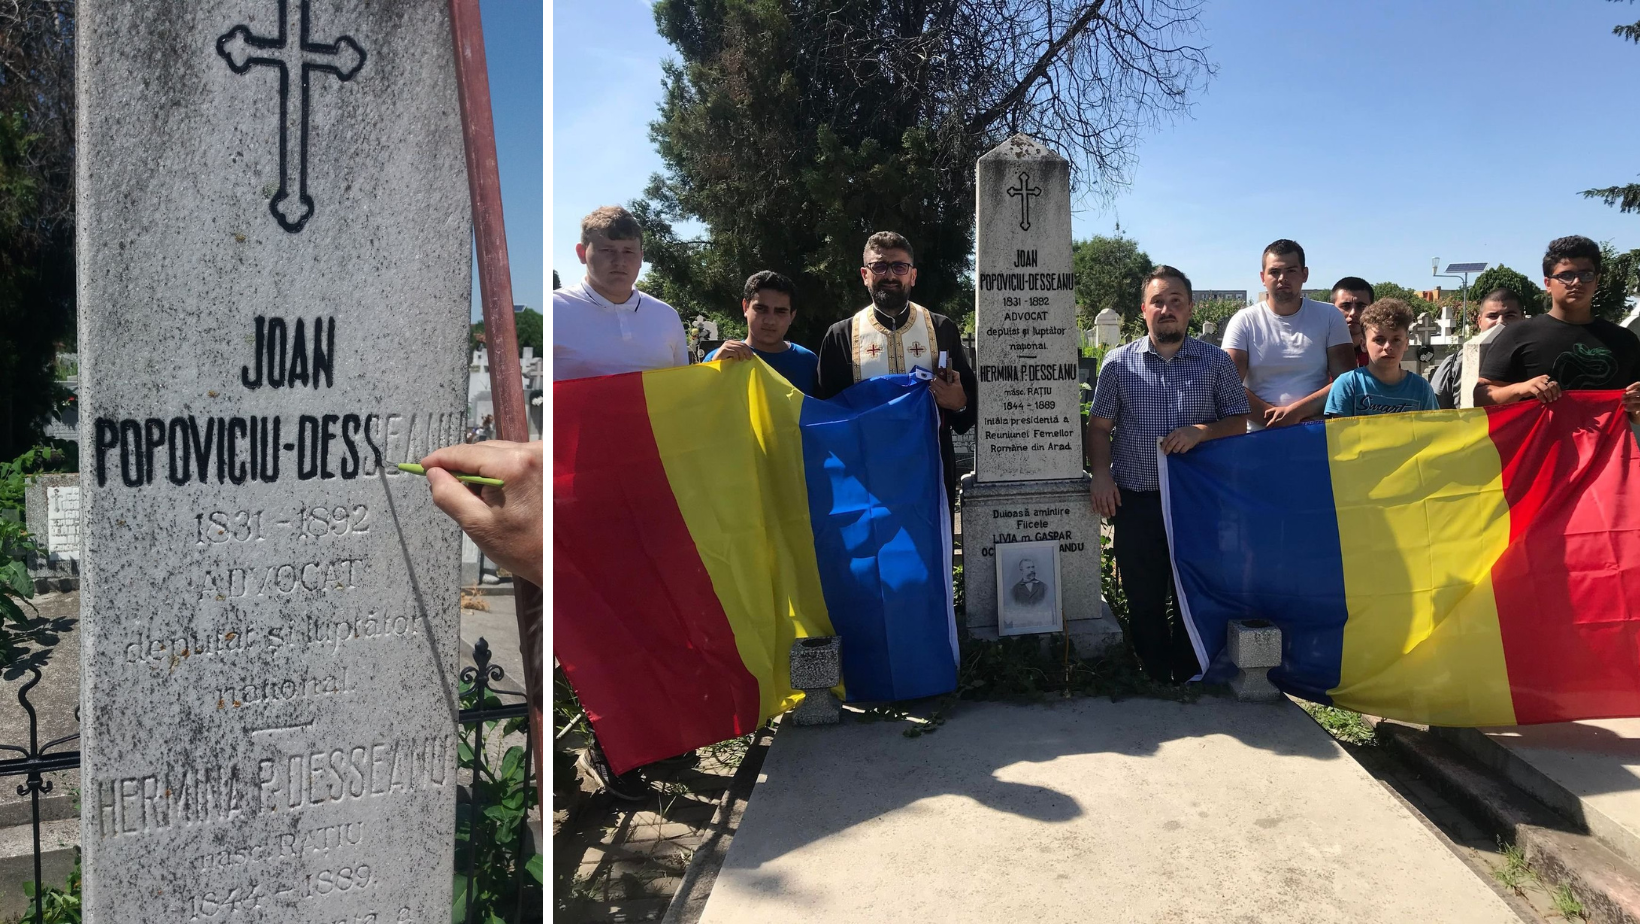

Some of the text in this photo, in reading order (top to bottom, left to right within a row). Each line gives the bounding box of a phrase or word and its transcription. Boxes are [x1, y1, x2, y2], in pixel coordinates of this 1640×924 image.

[1014, 249, 1038, 268] JOAN
[980, 272, 1074, 291] POPOVICIU-DESSEANU
[1003, 297, 1021, 307] 1831
[1004, 311, 1049, 321] ADVOCAT
[241, 314, 335, 390] JOAN
[980, 364, 1019, 382] HERMINA
[1003, 401, 1024, 411] 1844
[1034, 400, 1056, 410] 1889
[1356, 395, 1413, 413] Smart
[1031, 442, 1045, 451] din
[195, 509, 266, 545] 1831
[299, 504, 371, 540] 1892
[992, 532, 1018, 544] LIVIA
[1035, 530, 1072, 541] GASPAR
[200, 558, 364, 601] ADVOCAT
[99, 763, 247, 838] HERMINA
